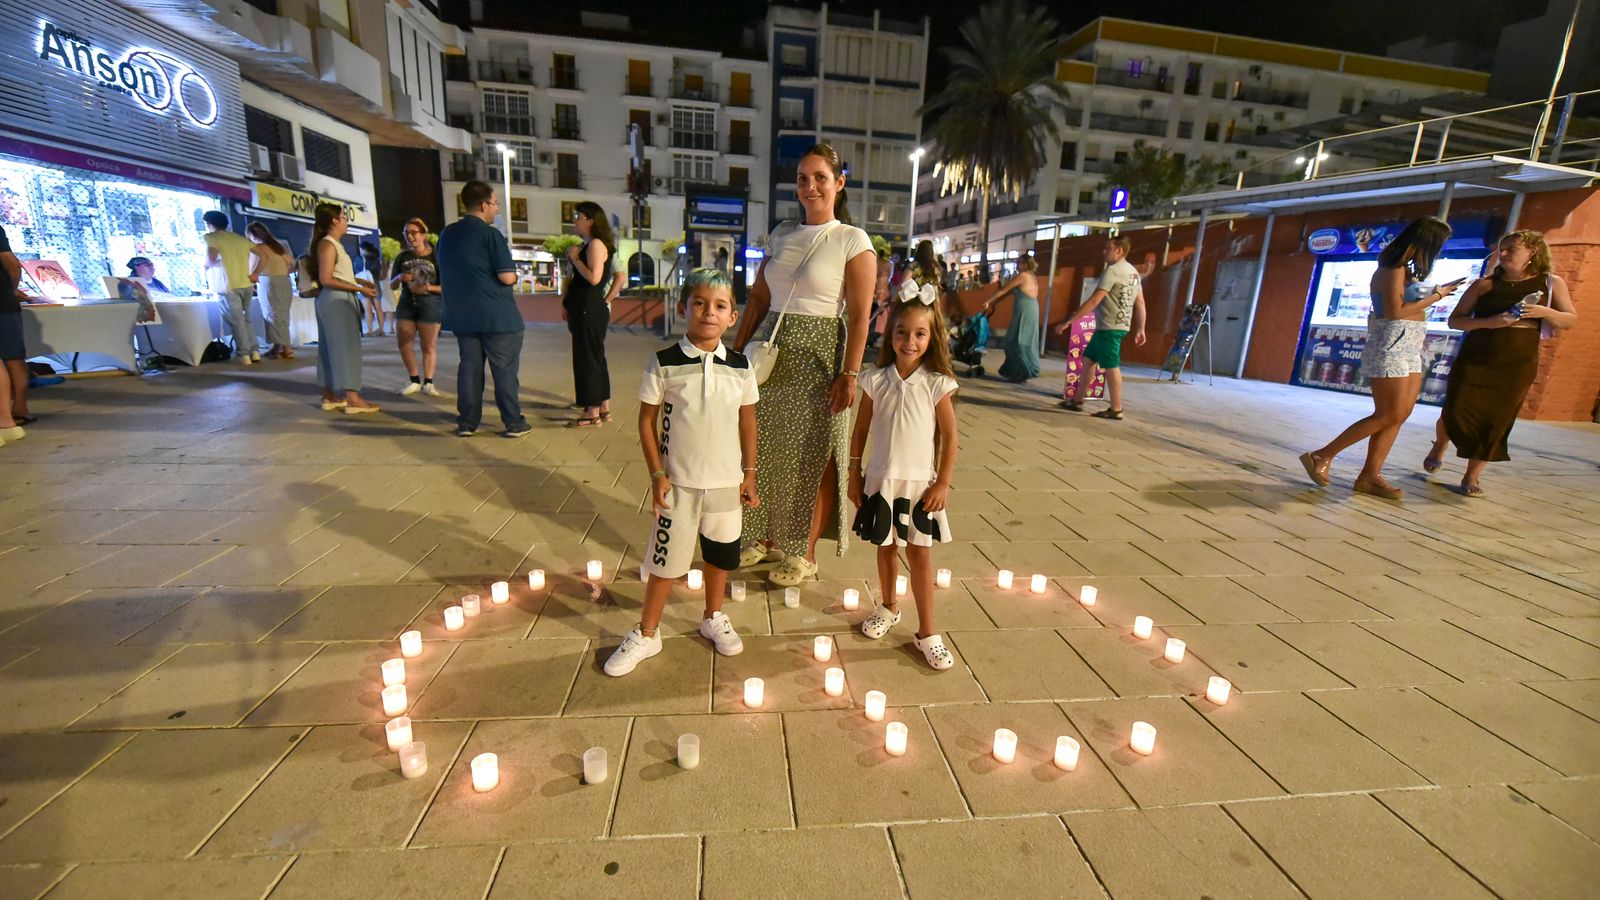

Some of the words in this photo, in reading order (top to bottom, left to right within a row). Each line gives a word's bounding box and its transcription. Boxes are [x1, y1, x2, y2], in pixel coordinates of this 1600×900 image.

[40, 22, 160, 98] Anson
[1115, 191, 1125, 207] P
[660, 401, 673, 456] BOSS
[653, 514, 672, 567] BOSS
